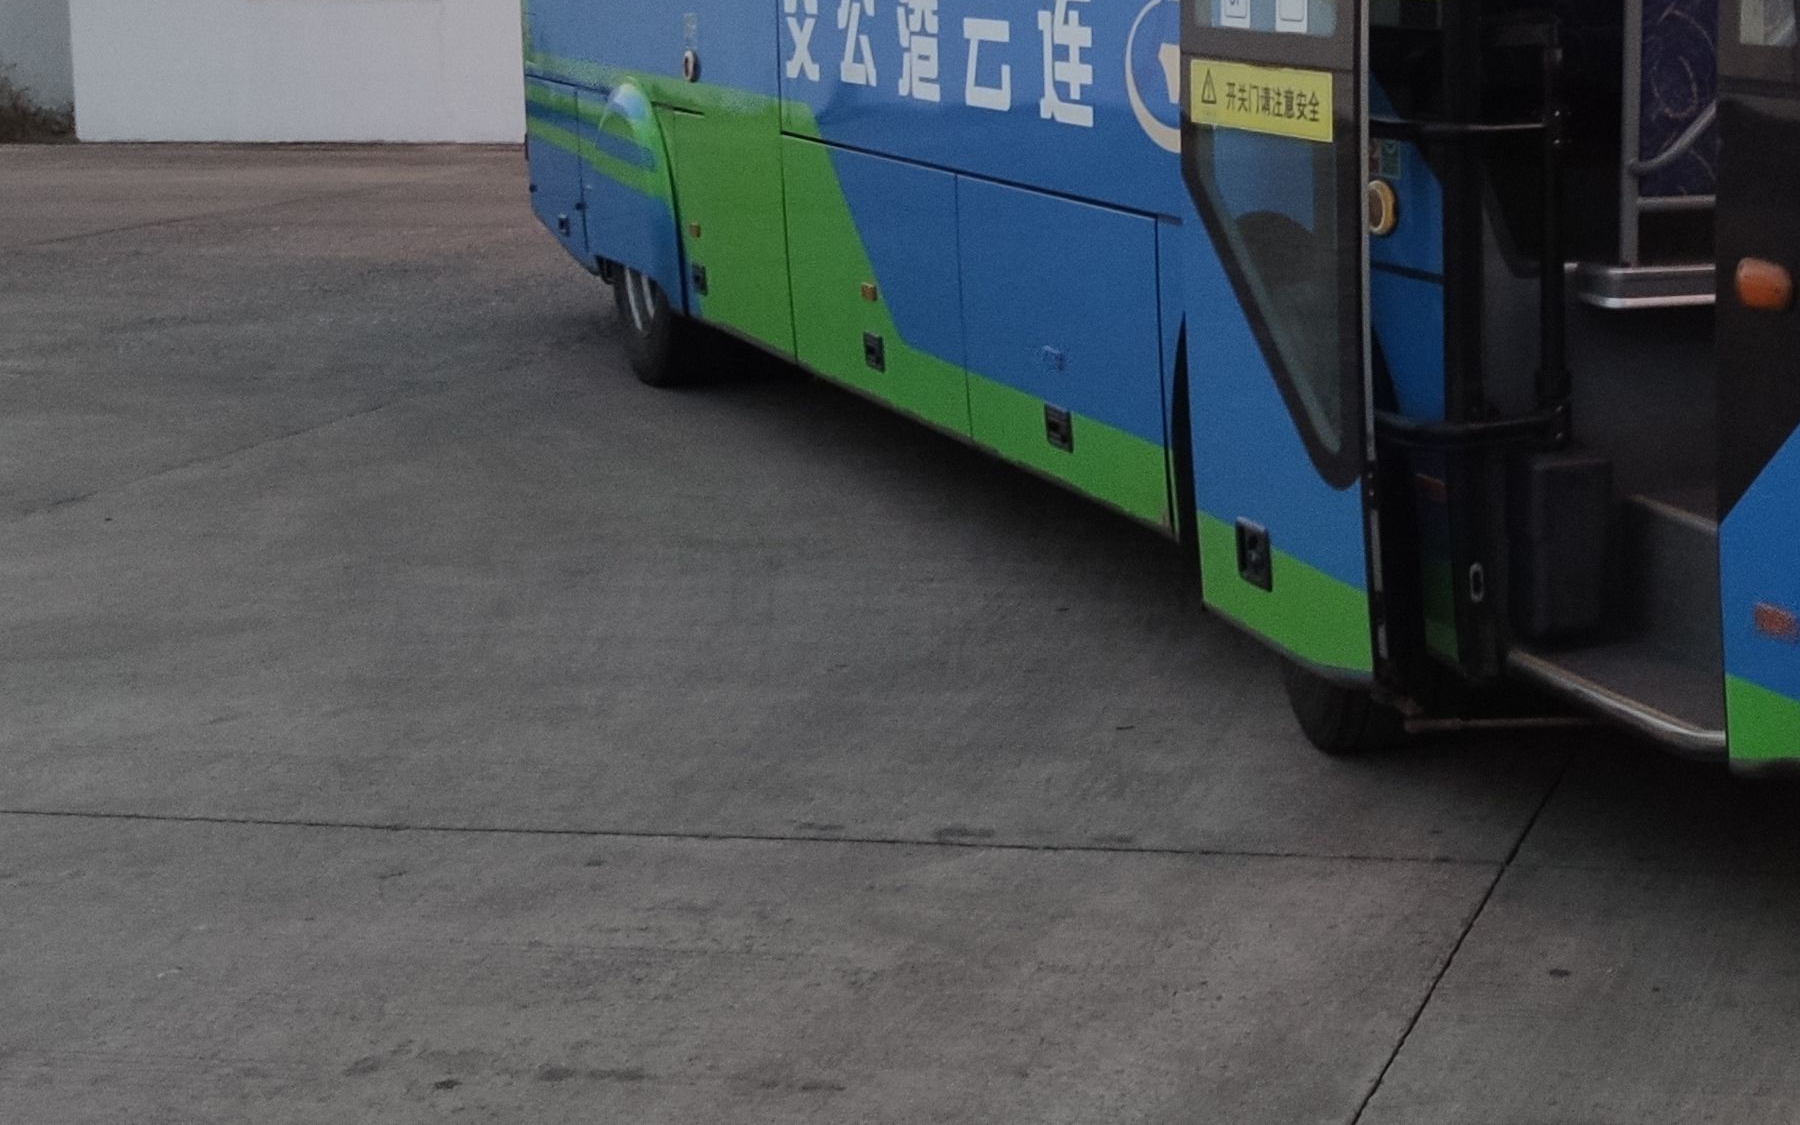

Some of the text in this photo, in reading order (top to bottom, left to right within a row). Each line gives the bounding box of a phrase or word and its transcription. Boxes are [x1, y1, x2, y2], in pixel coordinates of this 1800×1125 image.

[1225, 81, 1320, 122] 开关门请注意安全
